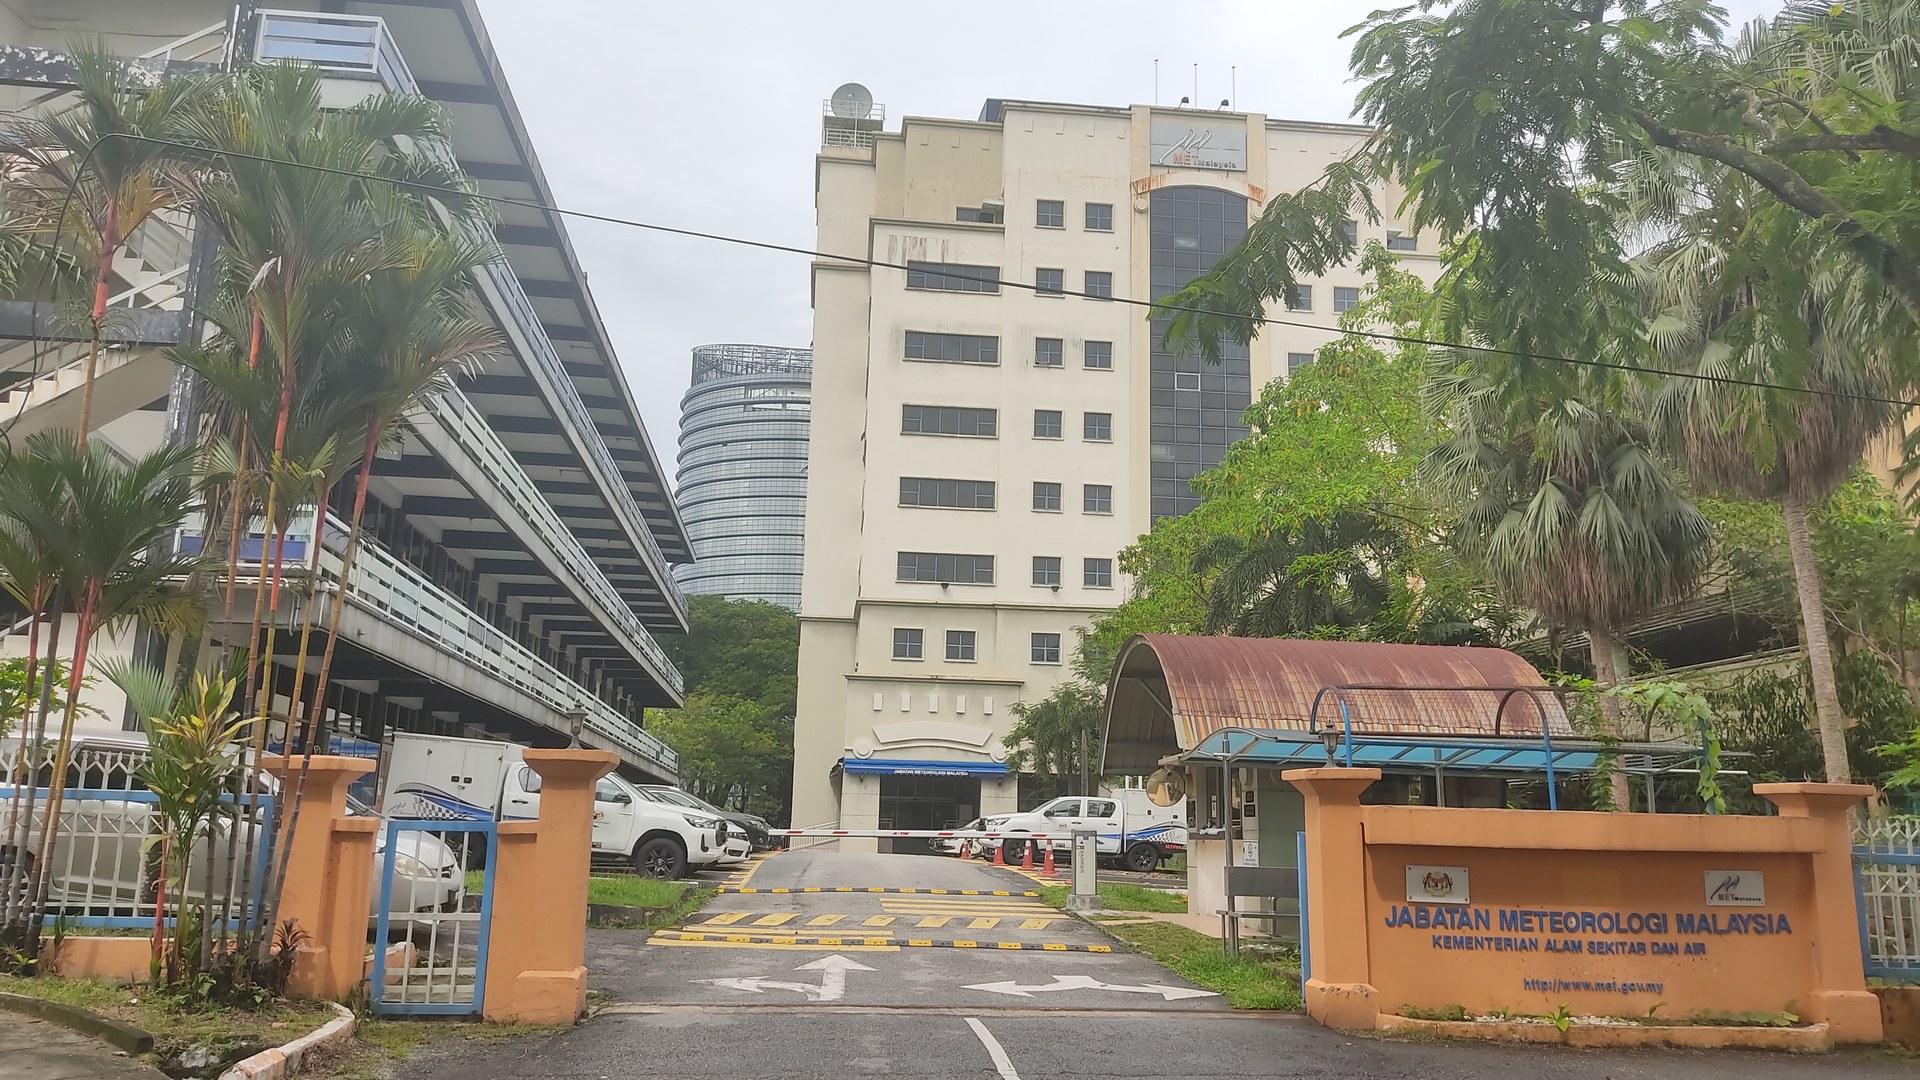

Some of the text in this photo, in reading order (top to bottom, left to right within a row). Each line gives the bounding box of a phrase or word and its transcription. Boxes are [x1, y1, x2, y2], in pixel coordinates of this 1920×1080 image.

[1385, 905, 1792, 935] JABATAN METEOROLOGI MALAYSIA
[1432, 934, 1707, 956] KEMENTERIAN ALAM SEKITAR DAN AIR
[1523, 978, 1664, 995] http://www.met.gov.my
